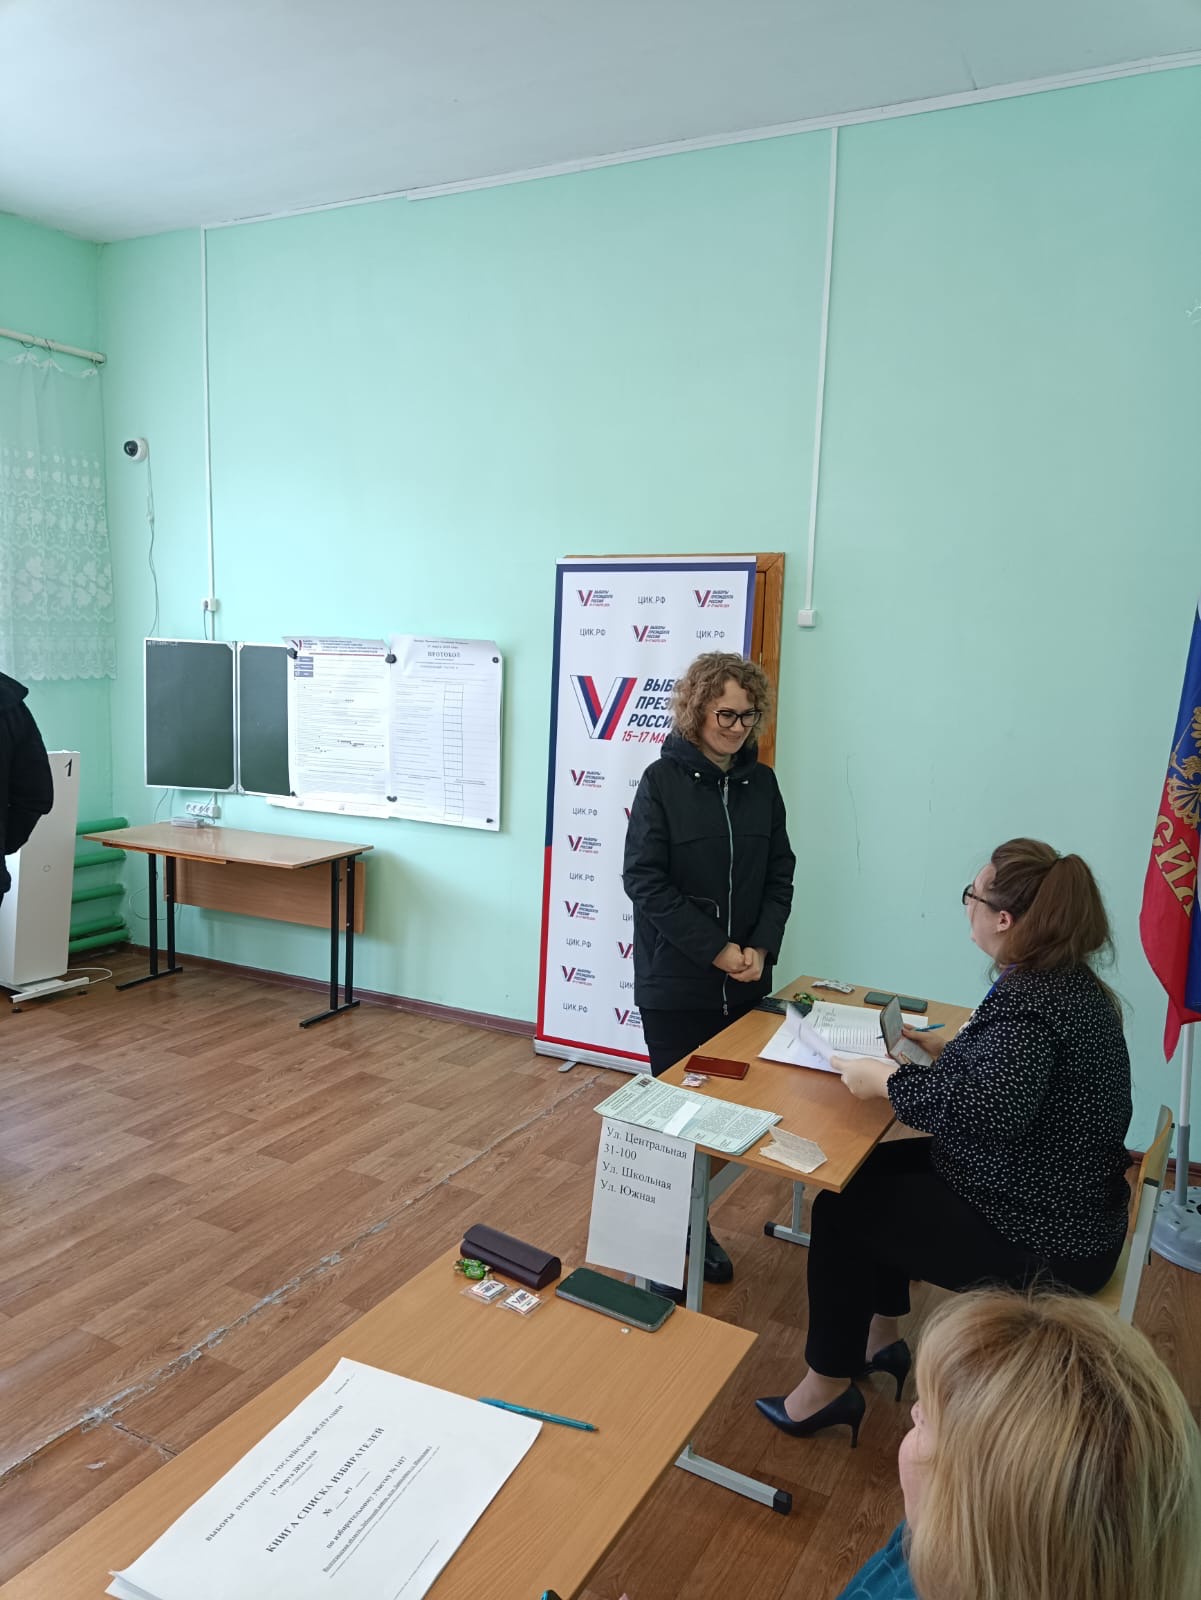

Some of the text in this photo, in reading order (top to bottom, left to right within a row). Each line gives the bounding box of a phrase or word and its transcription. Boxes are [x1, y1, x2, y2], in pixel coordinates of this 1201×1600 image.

[638, 596, 666, 605] ЦИК.РФ
[580, 628, 606, 637] ЦИК.РФ
[696, 630, 725, 640] ЦИК.РФ
[643, 678, 675, 692] ВЫБ
[635, 696, 672, 710] ПРЕЗ
[627, 714, 673, 728] РОССИ
[649, 732, 665, 744] МА
[64, 758, 73, 777] 1
[569, 872, 595, 882] ЦИК.РФ
[566, 938, 592, 948] ЦИК.РФ
[563, 1003, 588, 1013] ЦИК.РФ
[607, 1126, 687, 1159] Ул. Центральная
[603, 1143, 637, 1160] 31-100
[602, 1161, 672, 1190] Ул. Школьная
[600, 1179, 656, 1204] Ул. Южная
[205, 1512, 236, 1542] ВЫБОРЫ
[236, 1473, 276, 1511] ПРЕЗИДЕНТА
[275, 1435, 313, 1473] РОССИЙСКОЙ
[312, 1404, 344, 1436] ФЕДЕРАЦИИ
[270, 1488, 278, 1496] 17
[277, 1471, 295, 1490] марта
[294, 1460, 307, 1473] 2024
[305, 1449, 318, 1463] года
[265, 1520, 299, 1553] КНИГА
[297, 1484, 334, 1520] СПИСКА
[330, 1427, 385, 1484] ИЗБИРАТЕЛЕЙ
